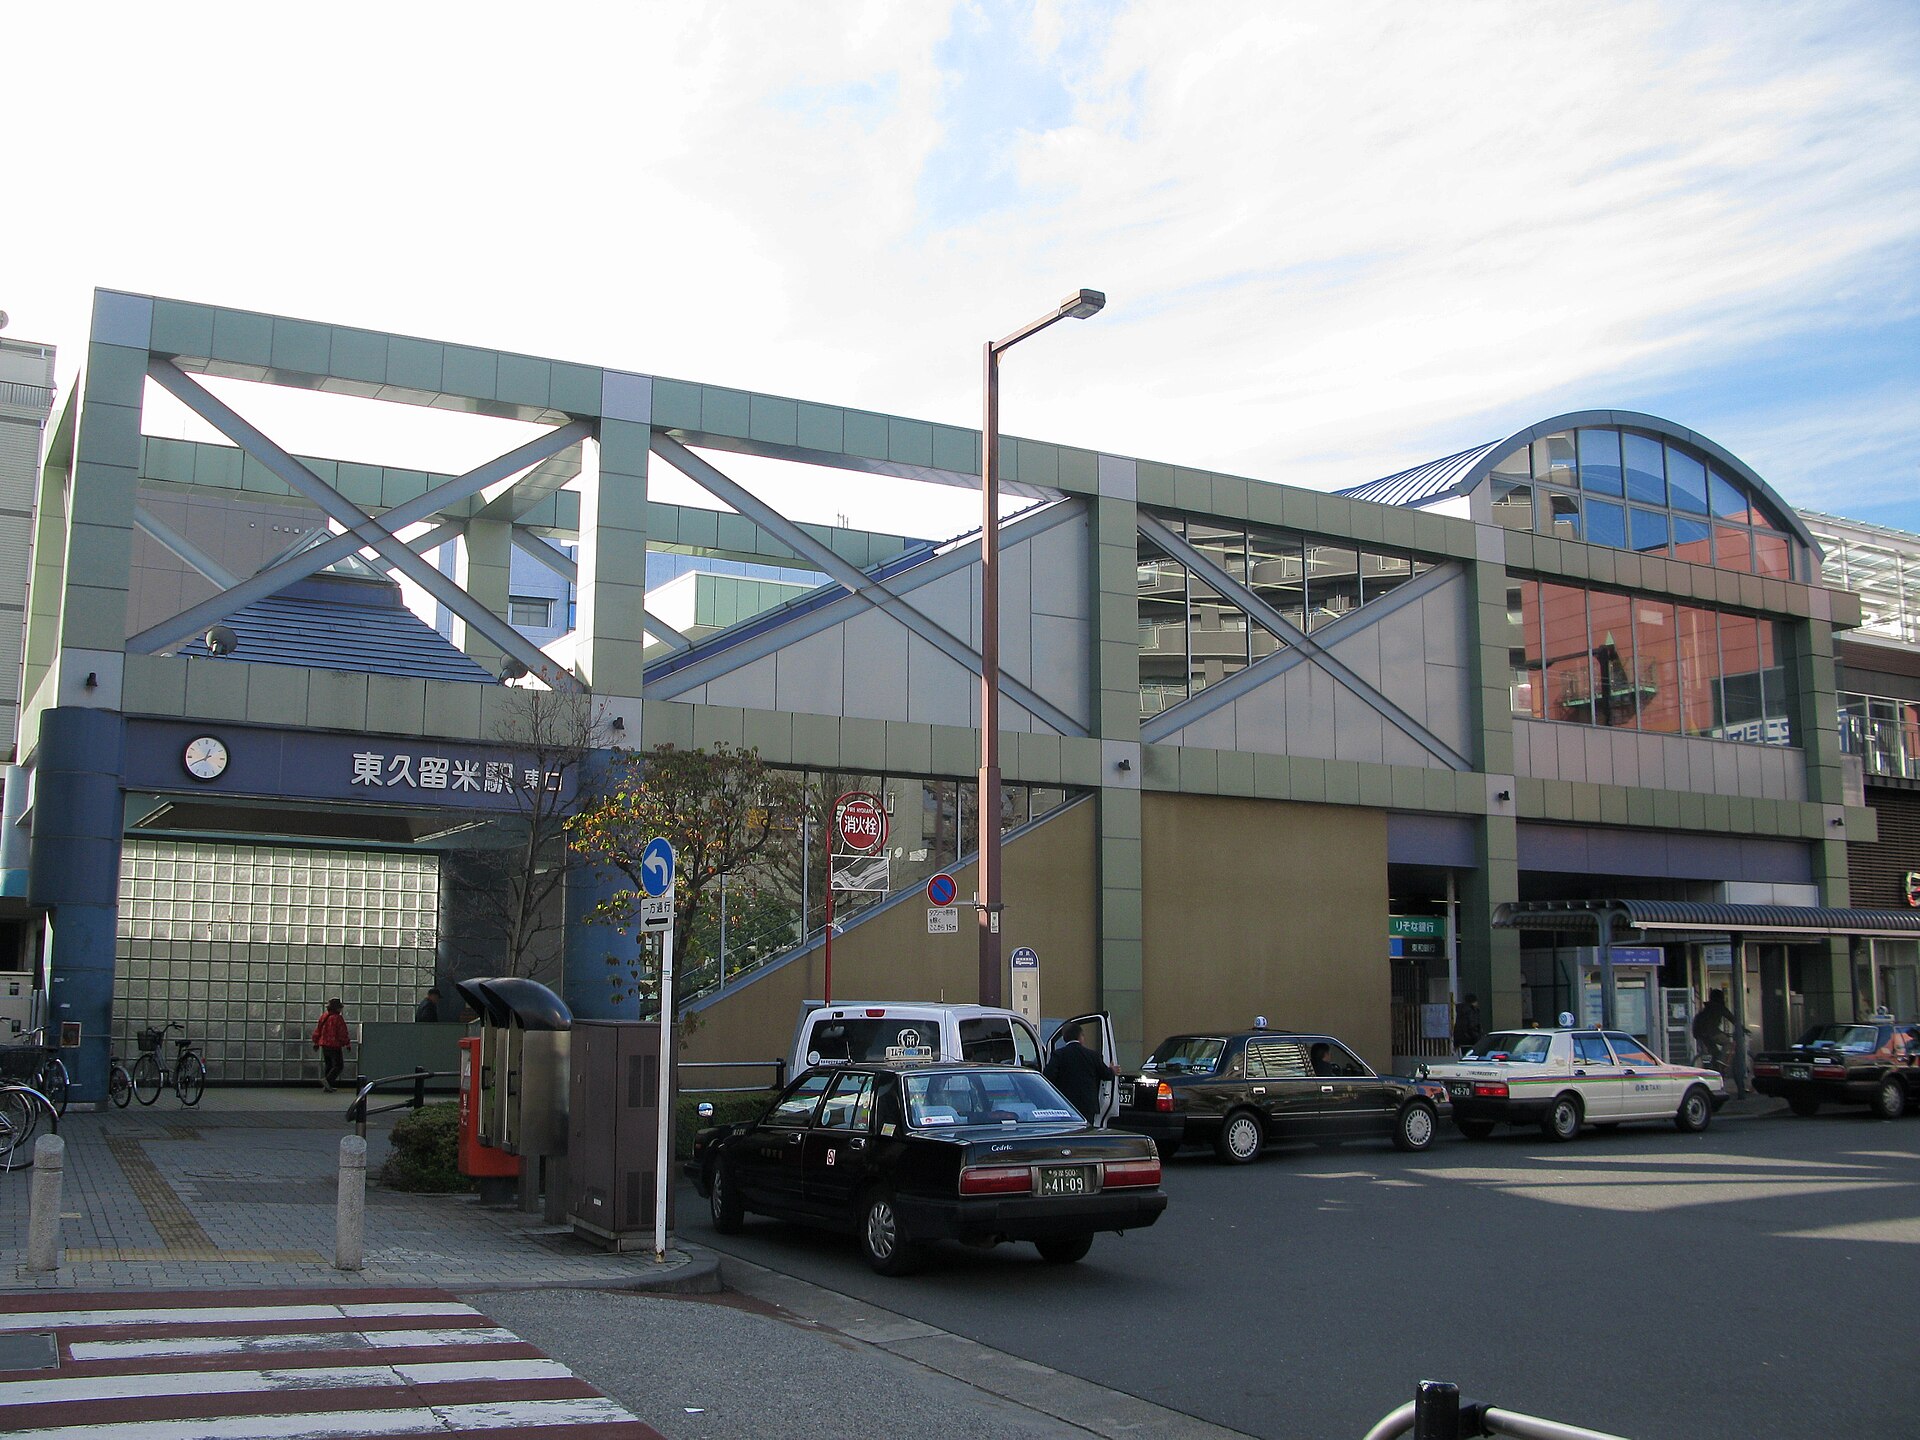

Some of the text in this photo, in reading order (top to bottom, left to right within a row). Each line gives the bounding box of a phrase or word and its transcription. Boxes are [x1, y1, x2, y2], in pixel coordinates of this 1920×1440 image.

[351, 751, 563, 794] 東久留米駅 東口
[844, 815, 878, 835] 消火栓
[643, 901, 671, 914] 一方通行
[1395, 920, 1434, 933] りそな銀行
[1052, 1177, 1084, 1192] 41-09
